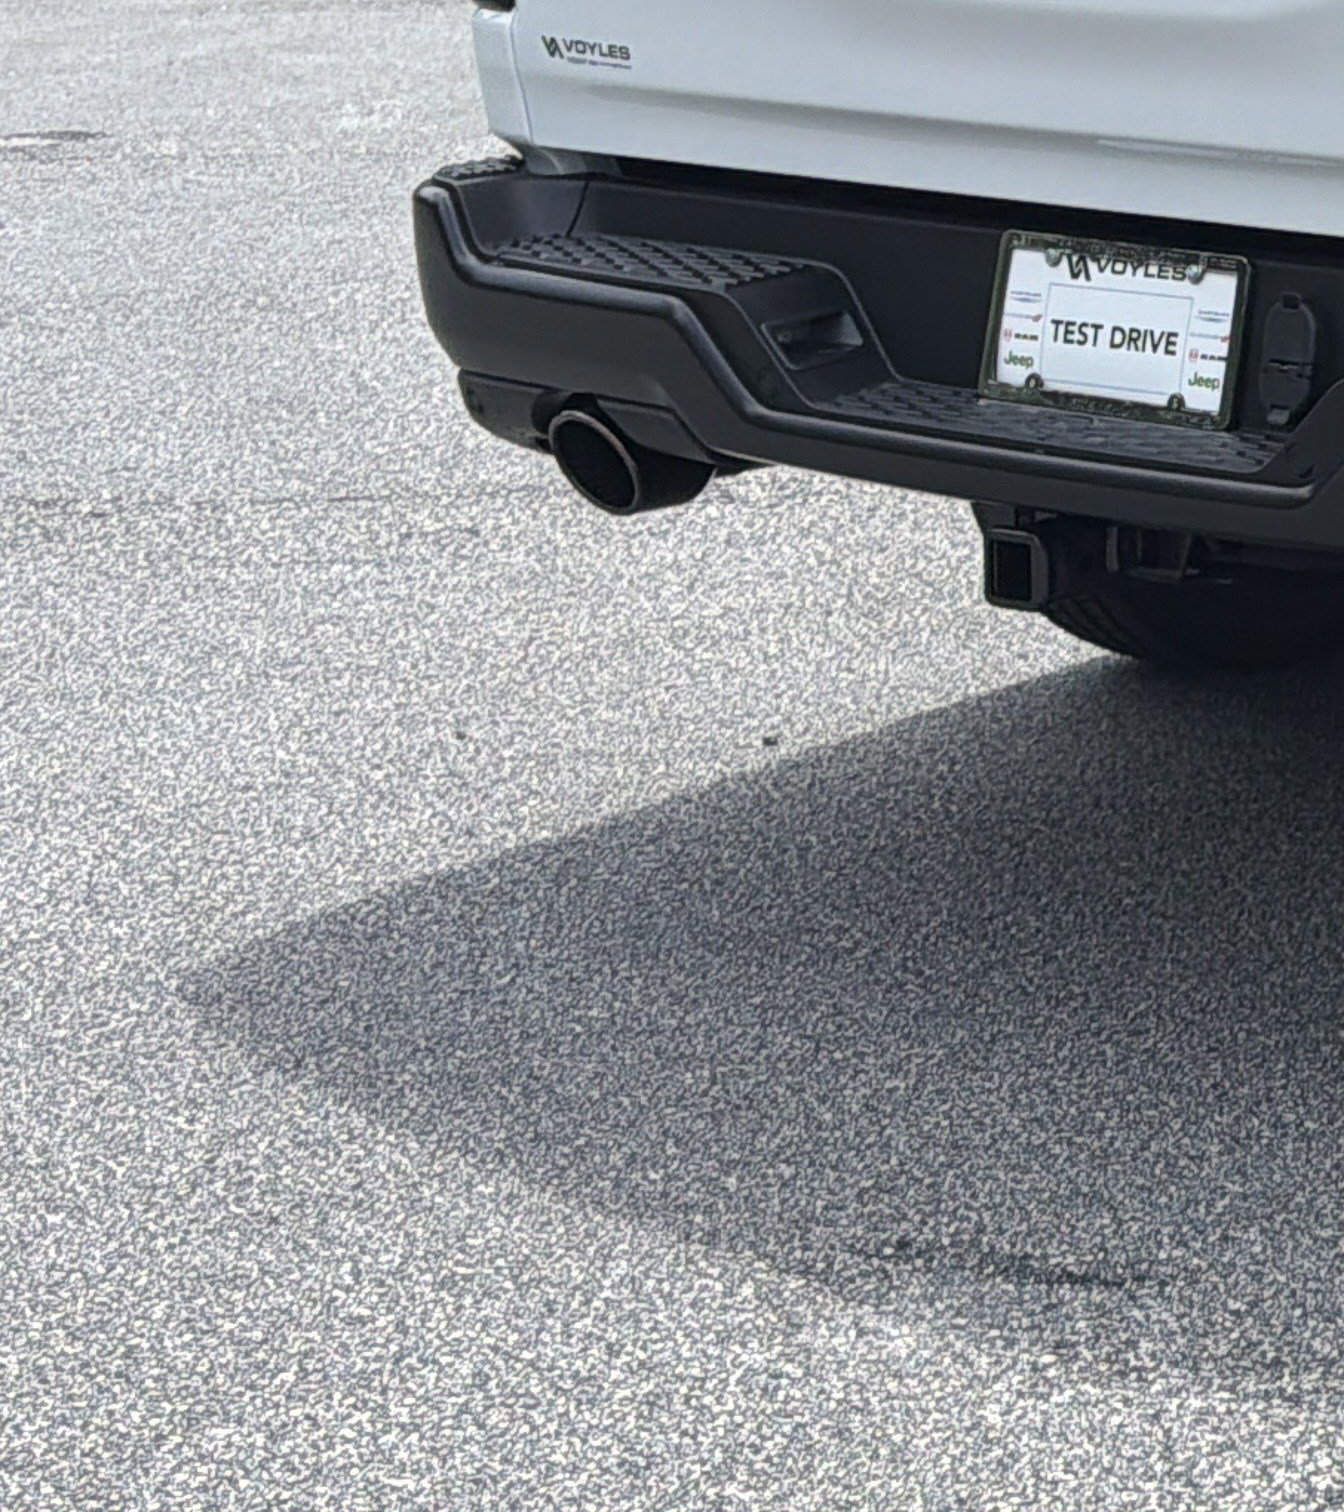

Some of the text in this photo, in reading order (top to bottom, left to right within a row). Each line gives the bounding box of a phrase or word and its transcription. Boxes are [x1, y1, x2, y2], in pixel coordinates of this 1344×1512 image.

[562, 37, 631, 61] VOYLES
[1095, 258, 1188, 282] VOYLES
[1050, 319, 1179, 356] TEST DRIVE
[1004, 350, 1035, 370] Jeep
[1188, 371, 1220, 392] Jeep
